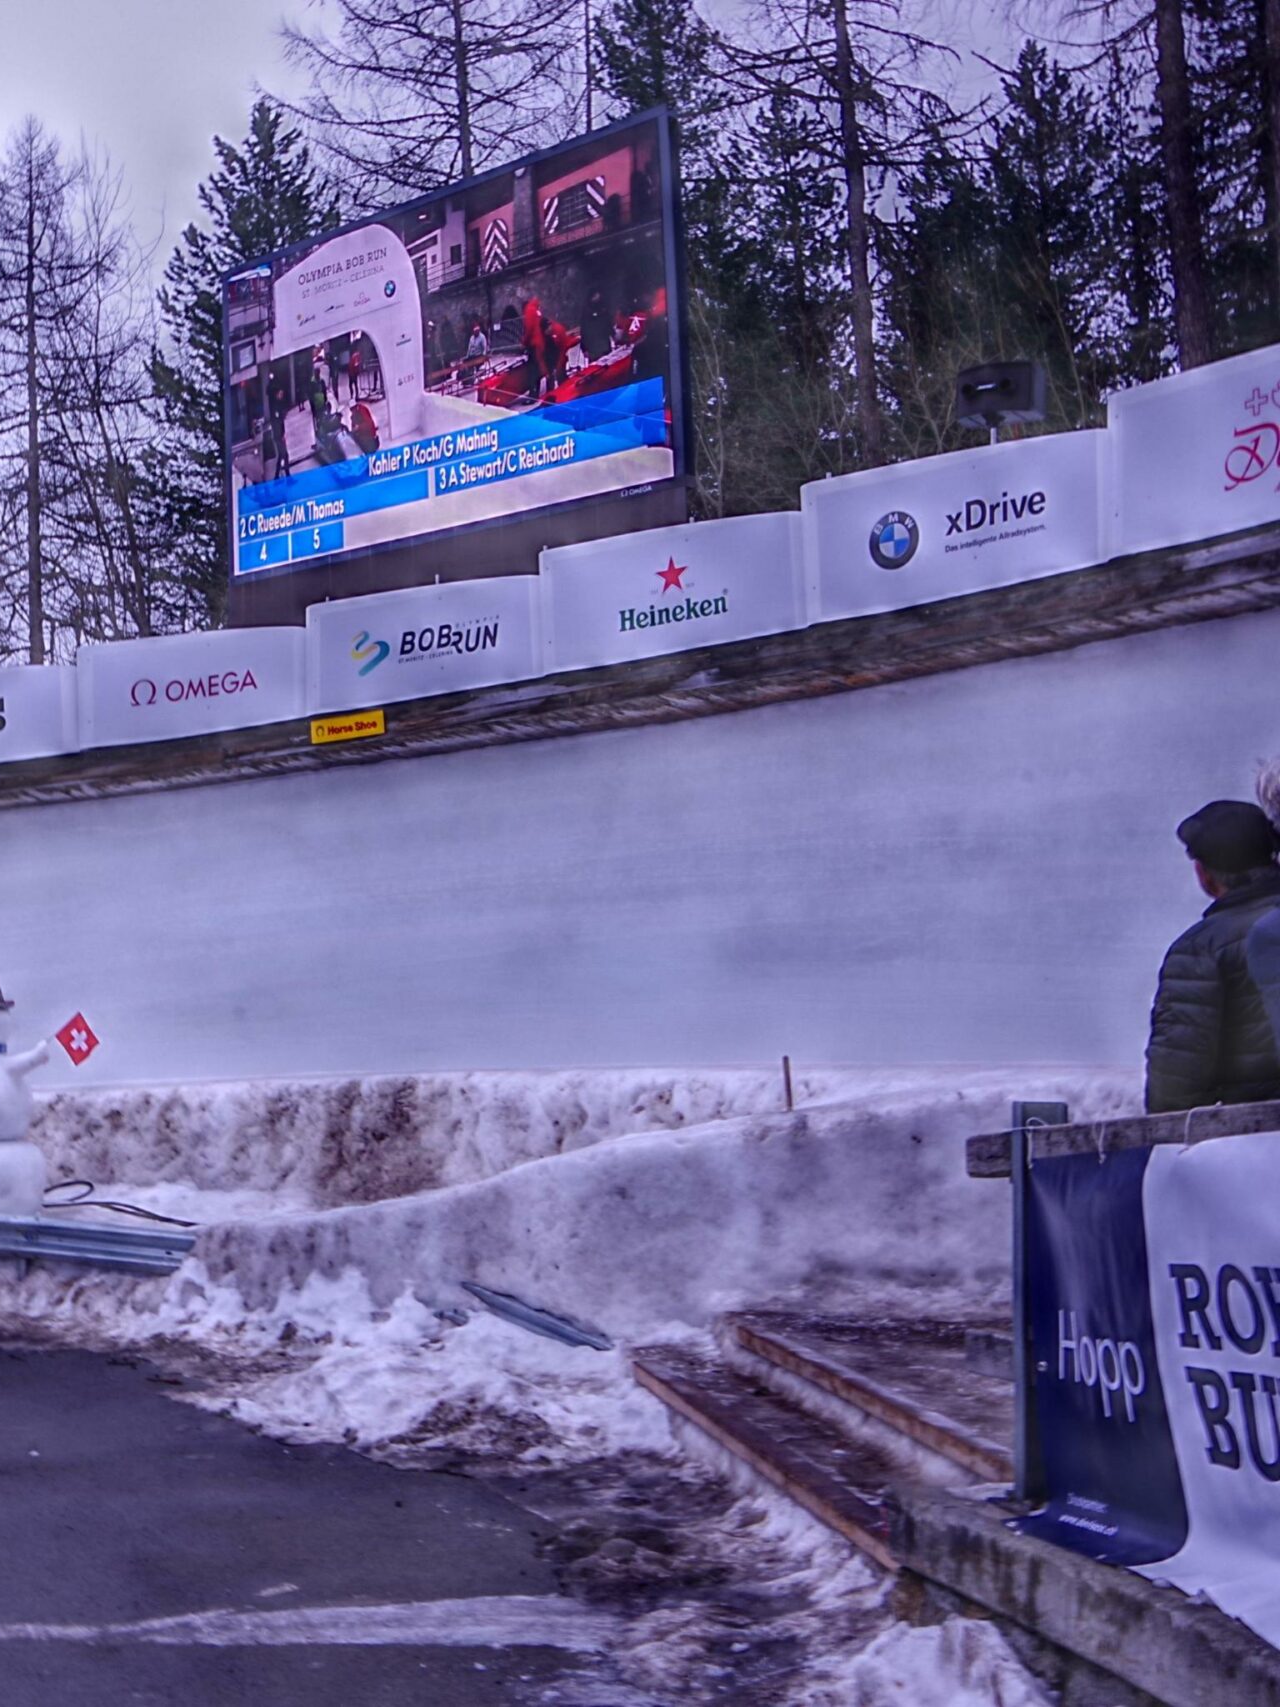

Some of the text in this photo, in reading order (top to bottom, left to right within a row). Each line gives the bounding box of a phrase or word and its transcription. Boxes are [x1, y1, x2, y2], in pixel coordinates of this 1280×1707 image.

[298, 247, 387, 285] OLYMPIA BOB RUN
[368, 426, 499, 477] Kohler P Koch/G Mahnig
[439, 436, 575, 490] 3 A Stewart/C Reichardt
[240, 498, 345, 538] 2 C Rueede/M Thomas
[945, 491, 1046, 537] xDrive
[260, 541, 267, 561] 4
[313, 527, 320, 550] 5
[944, 544, 958, 553] Das
[960, 535, 997, 548] intelligente
[618, 595, 729, 633] Heineken
[165, 668, 258, 702] OMEGA
[327, 720, 378, 736] Horse Shoe
[1058, 1308, 1145, 1423] Hopp
